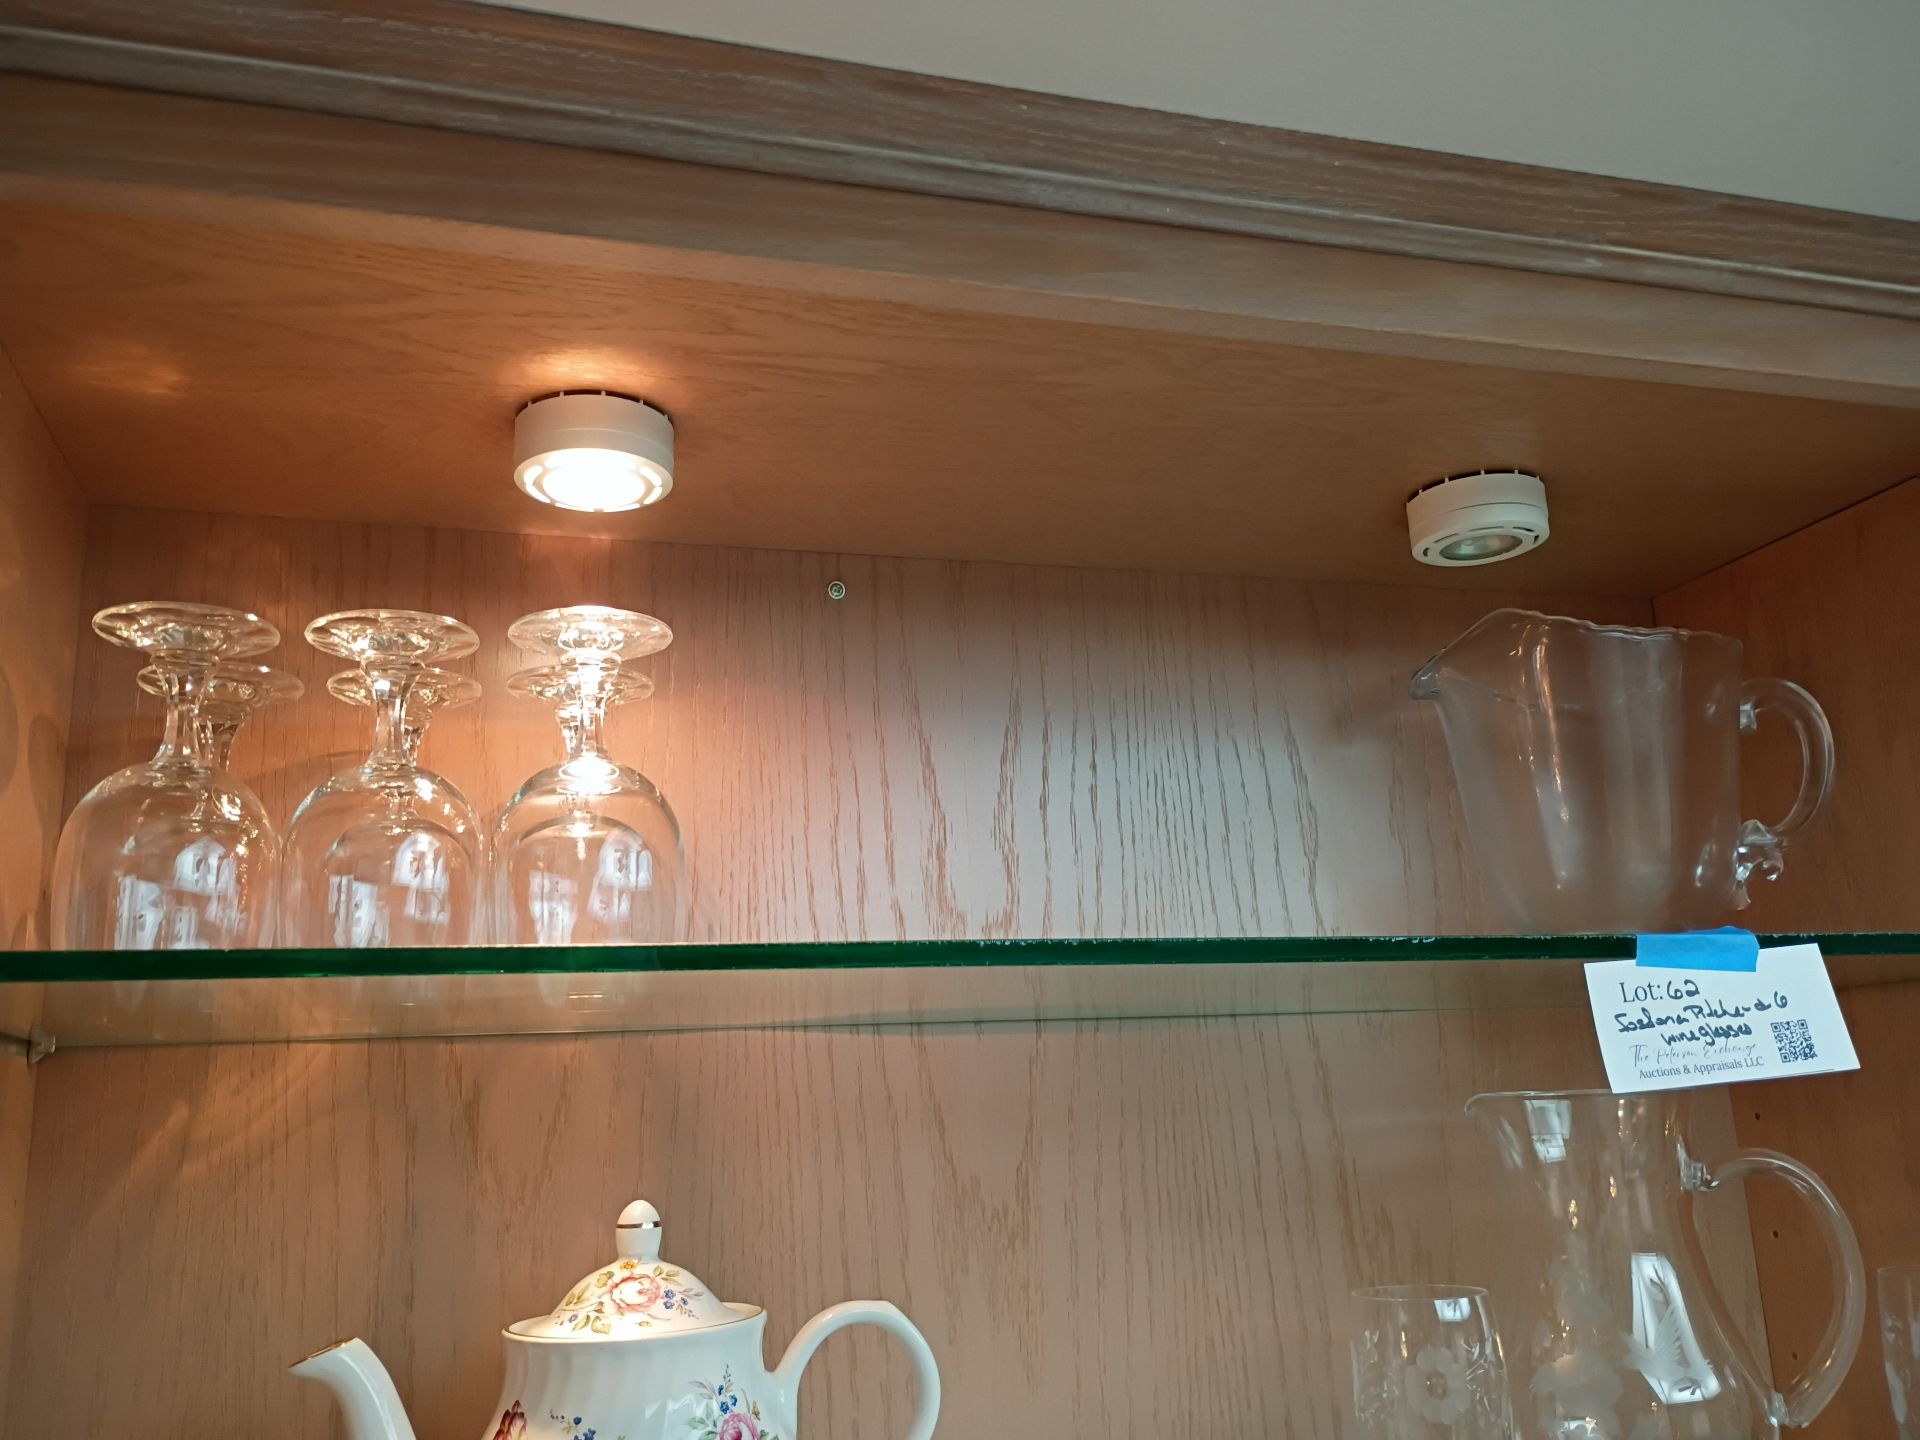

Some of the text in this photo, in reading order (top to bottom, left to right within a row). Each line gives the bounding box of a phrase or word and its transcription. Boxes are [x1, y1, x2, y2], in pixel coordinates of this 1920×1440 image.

[1619, 979, 1700, 1002] Lot: 62
[1774, 990, 1788, 1009] 6
[1629, 1044, 1648, 1068] The
[1639, 1056, 1765, 1079] Auctions & Appraisals LLC
